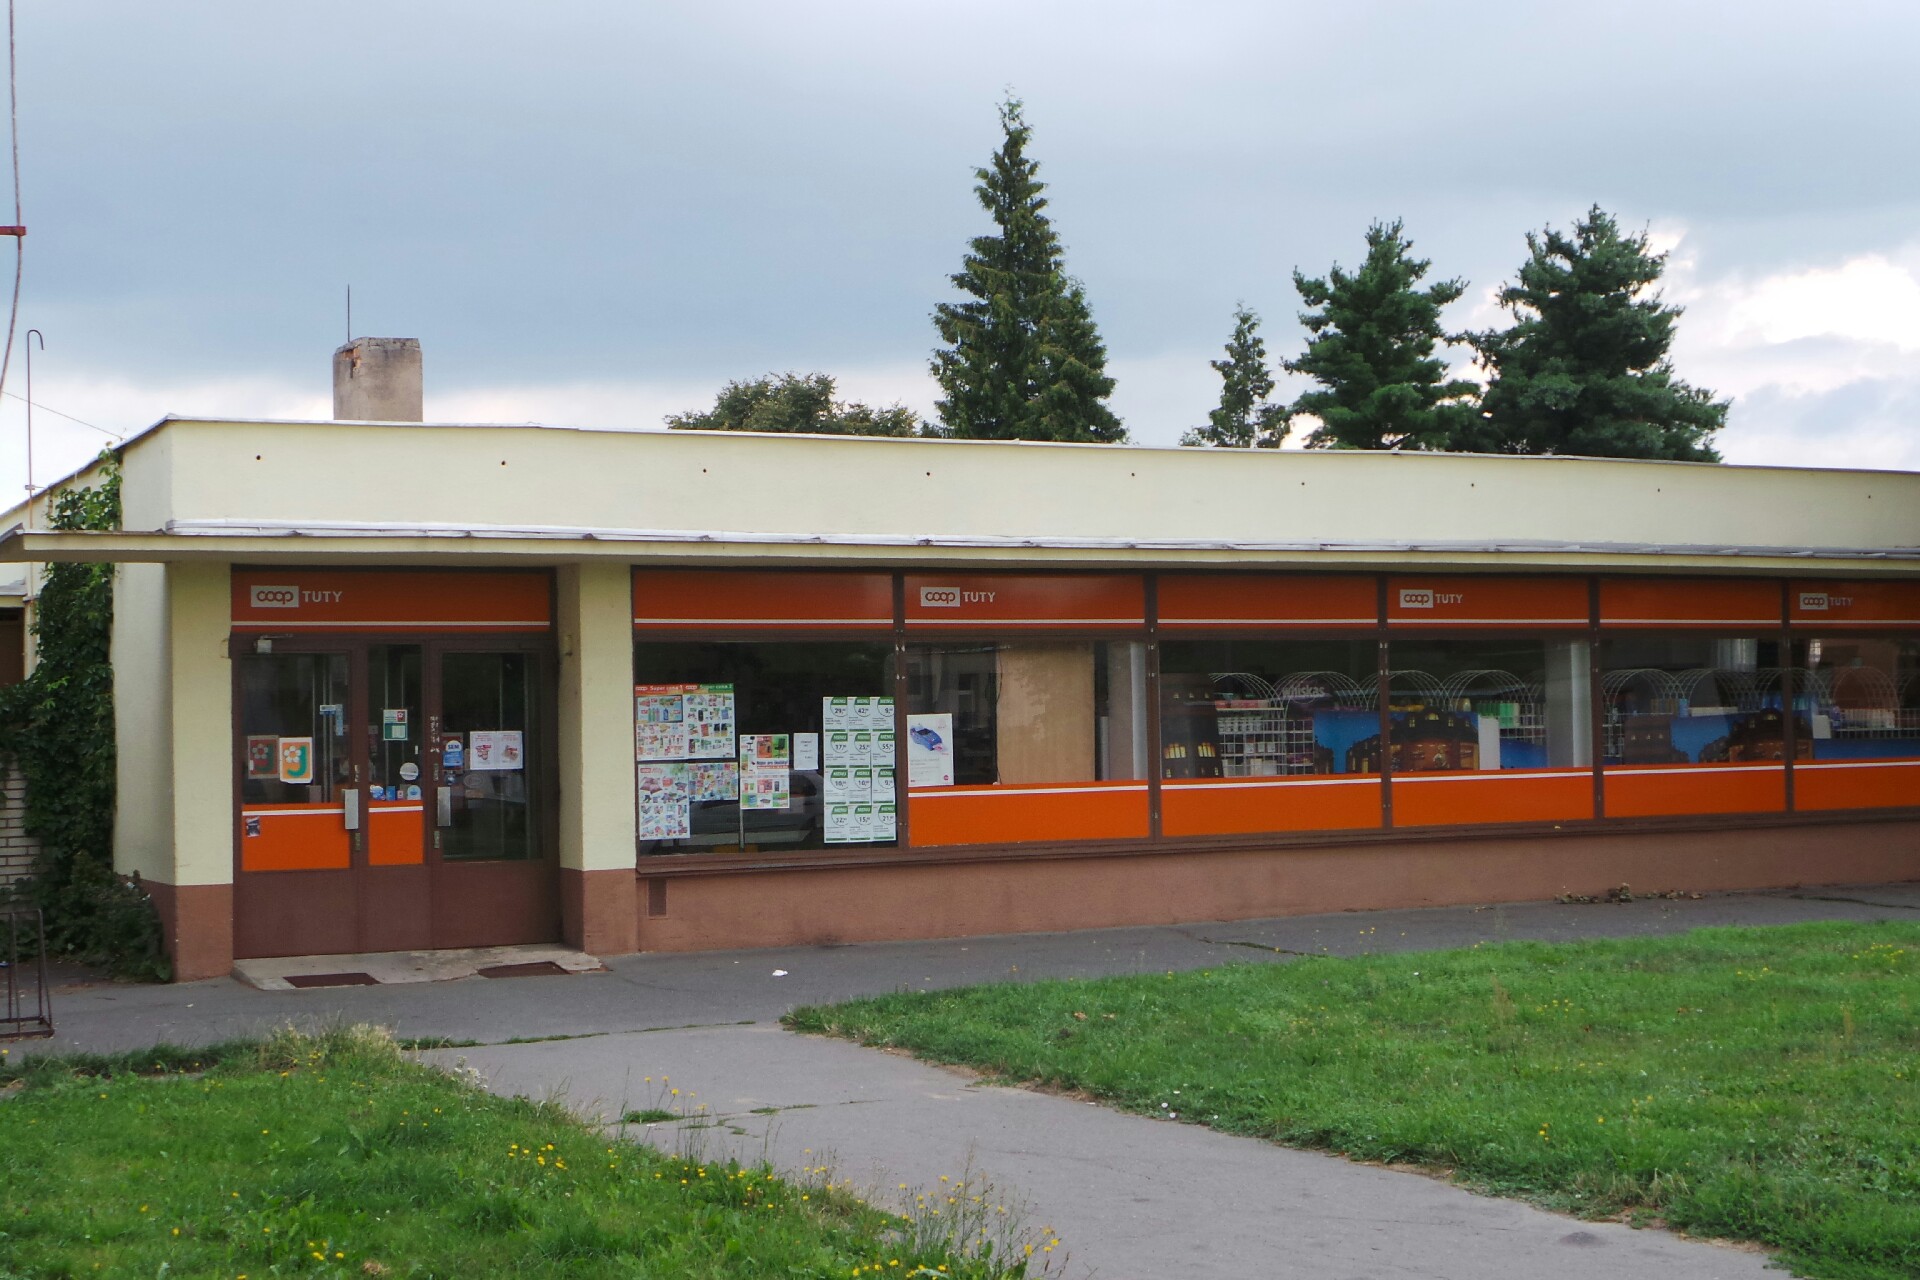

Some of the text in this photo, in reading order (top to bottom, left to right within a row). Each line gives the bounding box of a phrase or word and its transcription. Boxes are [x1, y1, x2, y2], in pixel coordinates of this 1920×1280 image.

[256, 590, 343, 605] coop TUTY
[925, 591, 996, 604] coop TUTY
[1403, 594, 1463, 606] coop TUTY
[1802, 596, 1854, 608] coop TUTY
[1282, 684, 1324, 696] whiskas
